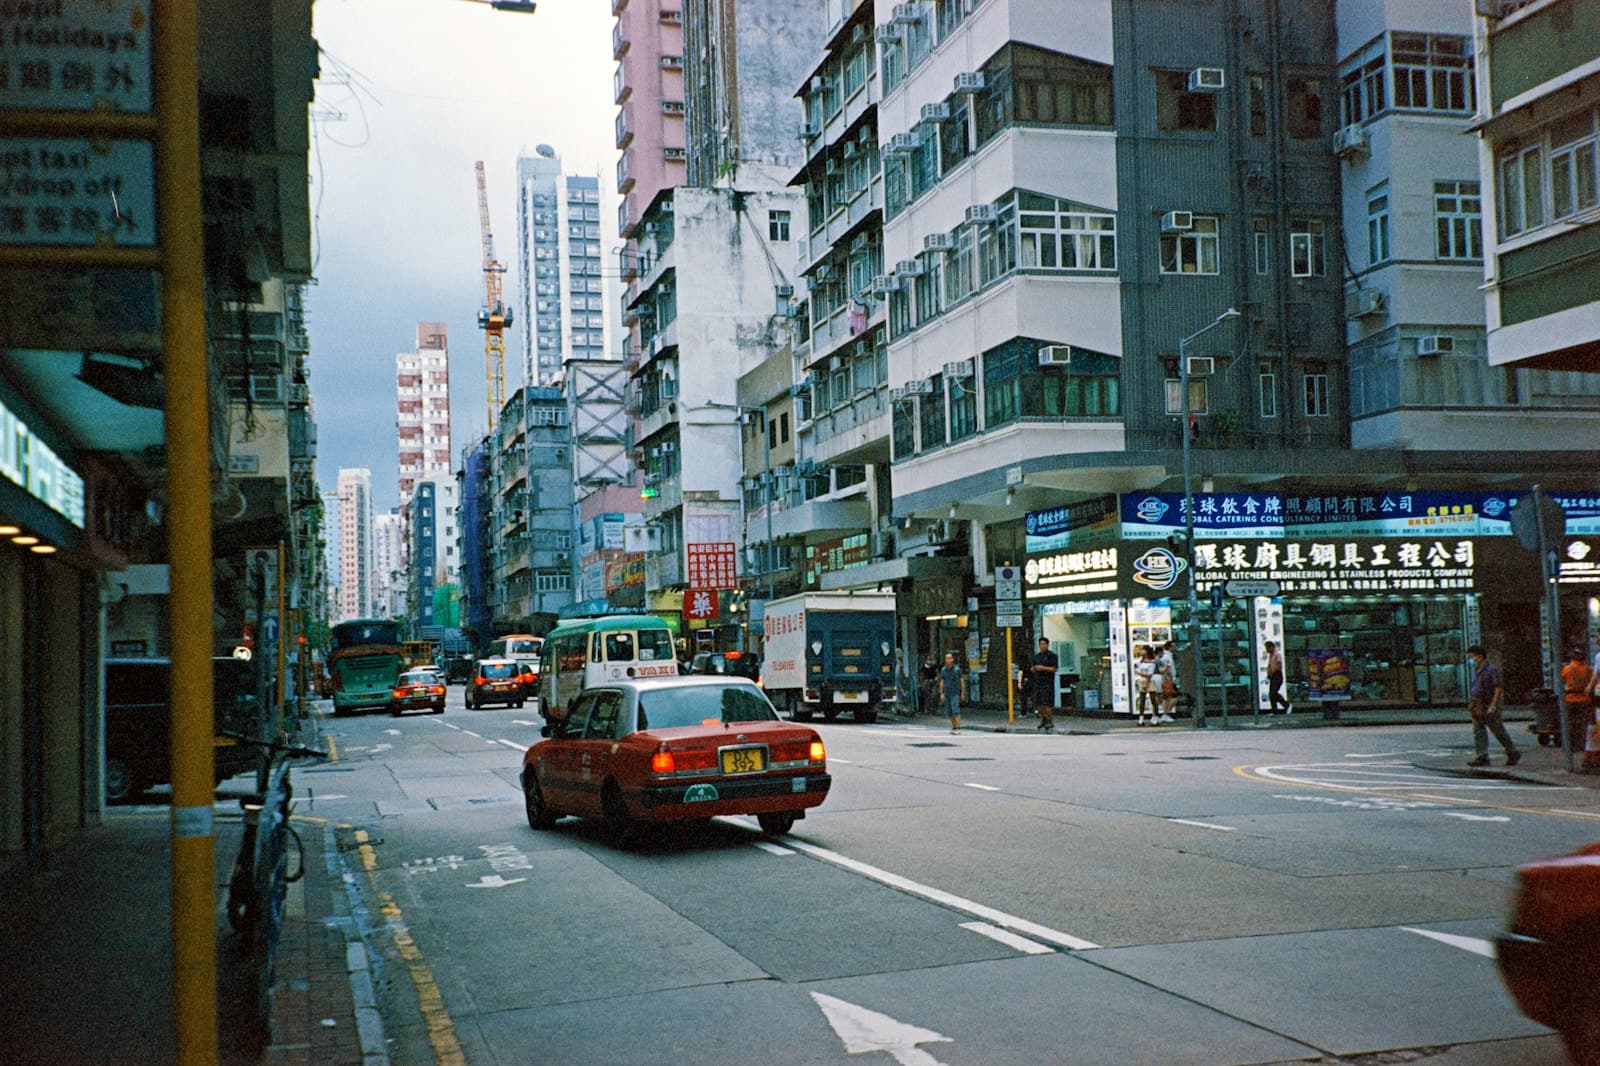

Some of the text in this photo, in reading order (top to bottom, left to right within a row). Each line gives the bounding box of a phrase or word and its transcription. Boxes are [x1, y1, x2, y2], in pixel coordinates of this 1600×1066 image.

[13, 25, 137, 53] Holidays
[1180, 515, 1213, 523] GOBAL
[1217, 515, 1257, 523] CATERING
[1261, 515, 1321, 523] CONSULTANCY
[1195, 569, 1474, 581] GLOBAL KITCHEN ENGINEERING & STAINLESS PRODUCTS COMPANY
[638, 665, 676, 676] TAXI
[731, 759, 756, 773] 392
